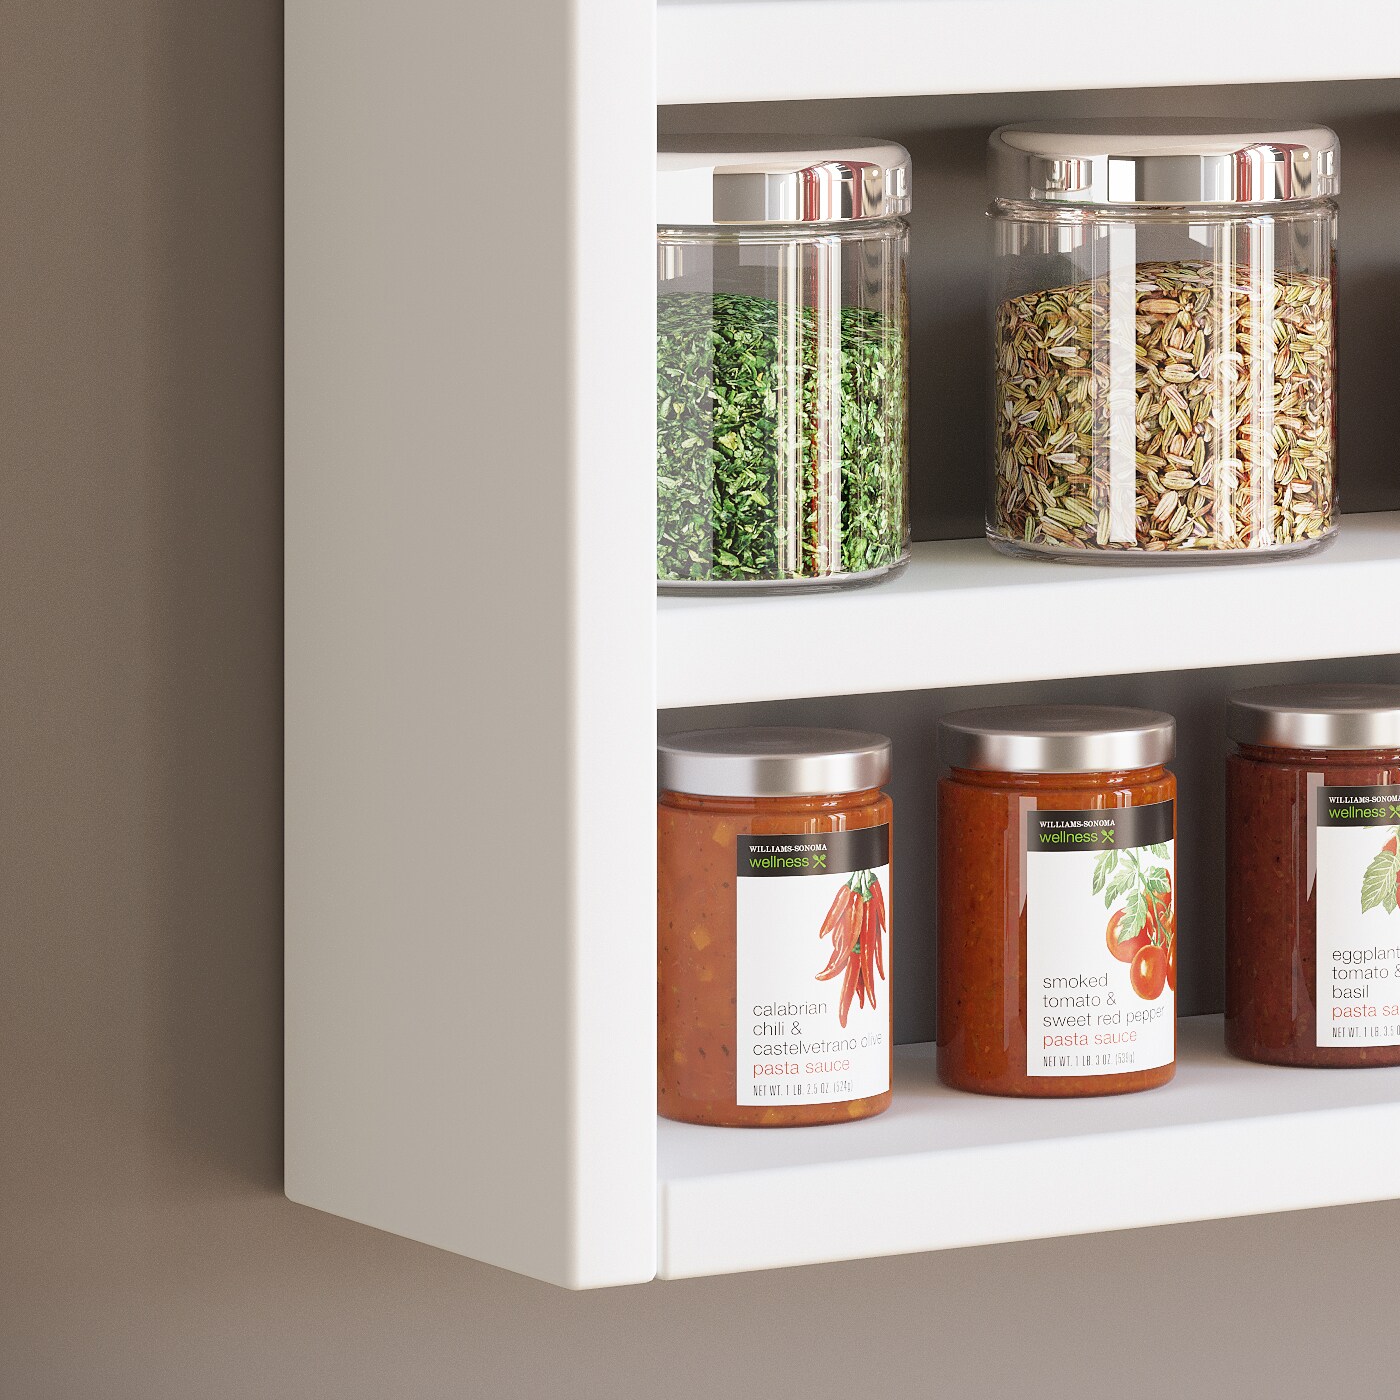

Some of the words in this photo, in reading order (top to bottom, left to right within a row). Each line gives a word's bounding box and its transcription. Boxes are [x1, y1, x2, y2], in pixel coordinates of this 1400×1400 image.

[1329, 805, 1386, 819] wellness
[1040, 820, 1115, 828] WILLIAMS-SONOMA
[1040, 830, 1098, 844] wellness
[749, 843, 827, 853] WILLIAMS-SONOMA
[749, 855, 809, 869] wellness
[1332, 965, 1389, 980] tomato
[1043, 973, 1108, 989] smoked
[1332, 985, 1369, 999] basil
[1043, 994, 1100, 1008] tomato
[1106, 992, 1116, 1006] &
[753, 1001, 827, 1017] calabrian
[1043, 1013, 1091, 1028] sweet
[1098, 1010, 1121, 1026] red
[1126, 1005, 1164, 1025] pepper
[1332, 1003, 1377, 1021] pasta
[753, 1021, 784, 1036] chili
[791, 1021, 802, 1035] &
[1333, 1027, 1345, 1037] NET
[1348, 1027, 1361, 1037] WT.
[1364, 1027, 1367, 1037] 1
[753, 1037, 857, 1057] castelvetrano
[861, 1032, 882, 1047] olive
[1043, 1032, 1088, 1050] pasta
[1094, 1030, 1137, 1046] sauce
[753, 1060, 799, 1079] pasta
[806, 1059, 850, 1074] sauce
[1044, 1056, 1056, 1067] NET
[1060, 1056, 1072, 1066] WT.
[1076, 1056, 1078, 1066] 1
[754, 1085, 766, 1096] NET
[770, 1085, 782, 1096] WT.
[786, 1085, 789, 1095] 1
